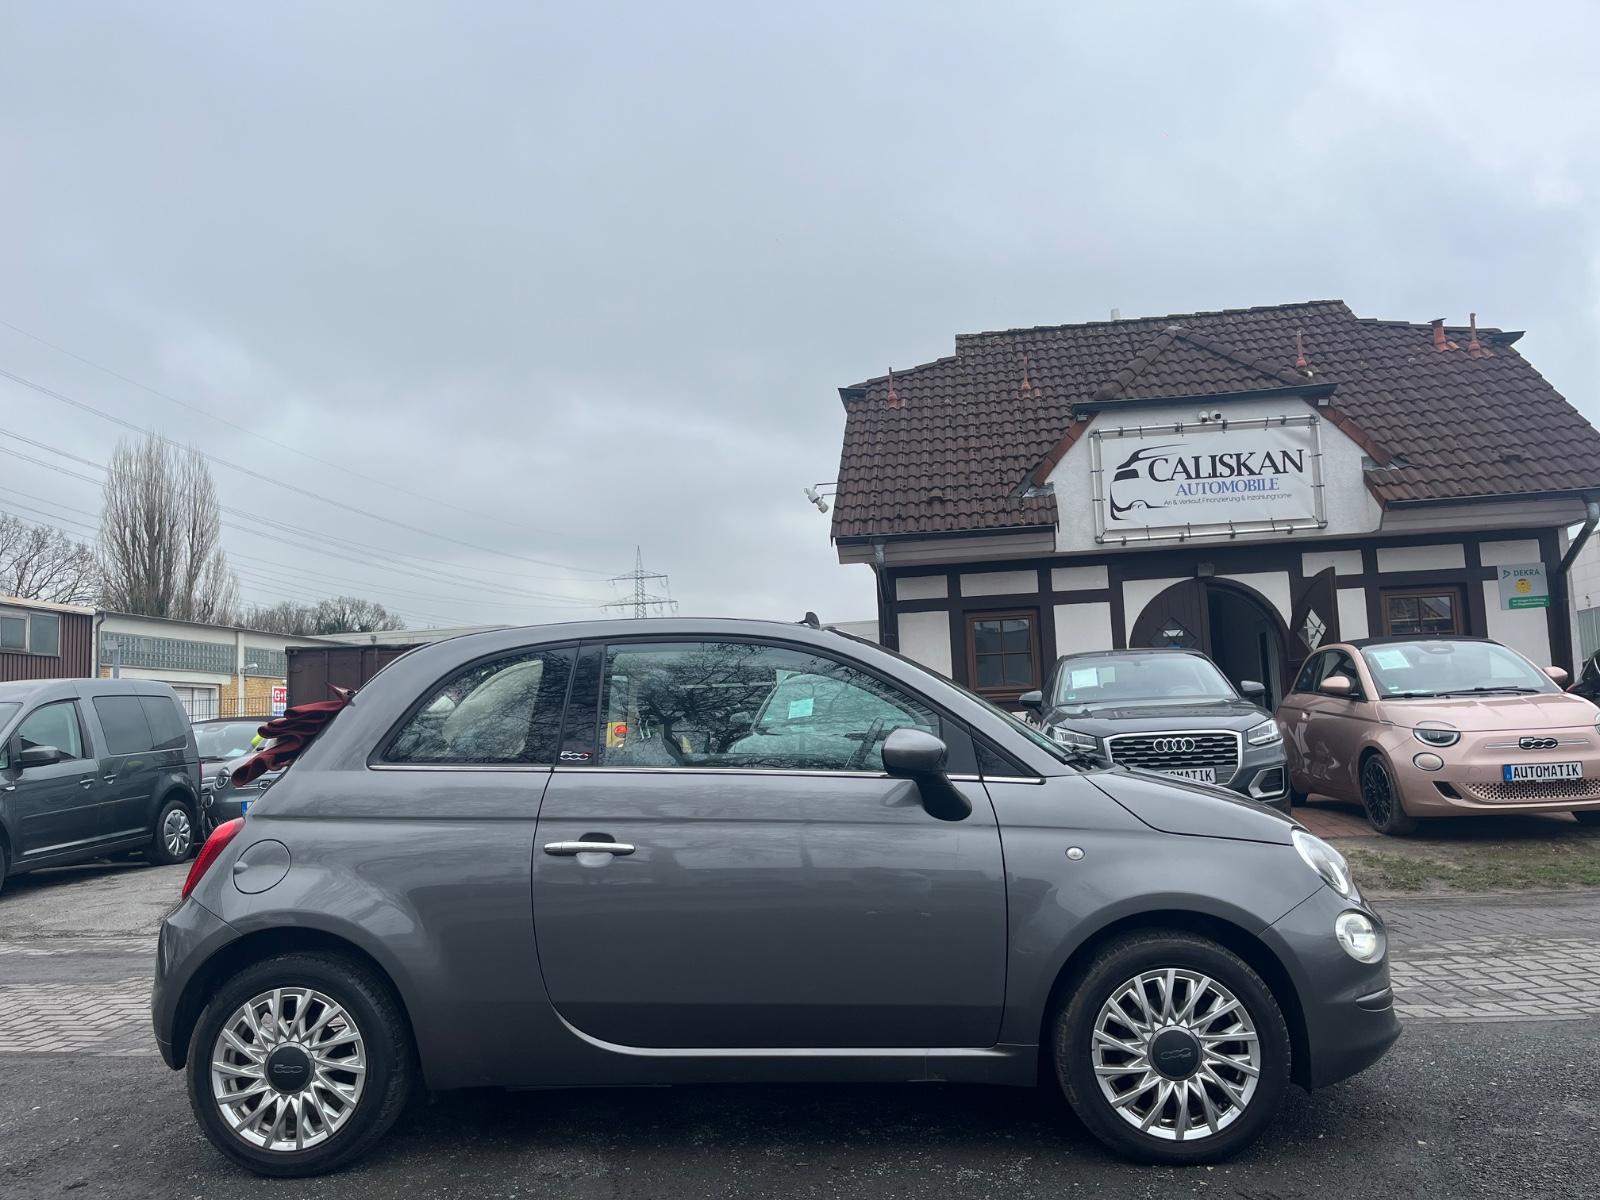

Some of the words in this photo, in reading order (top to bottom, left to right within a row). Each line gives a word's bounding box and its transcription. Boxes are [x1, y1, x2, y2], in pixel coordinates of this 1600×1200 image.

[1148, 449, 1304, 482] CALISKAN
[1175, 478, 1280, 496] AUTOMOBILE
[1513, 569, 1541, 577] DEKRA
[1519, 737, 1558, 750] 500
[1513, 764, 1579, 778] AUTOMATIK
